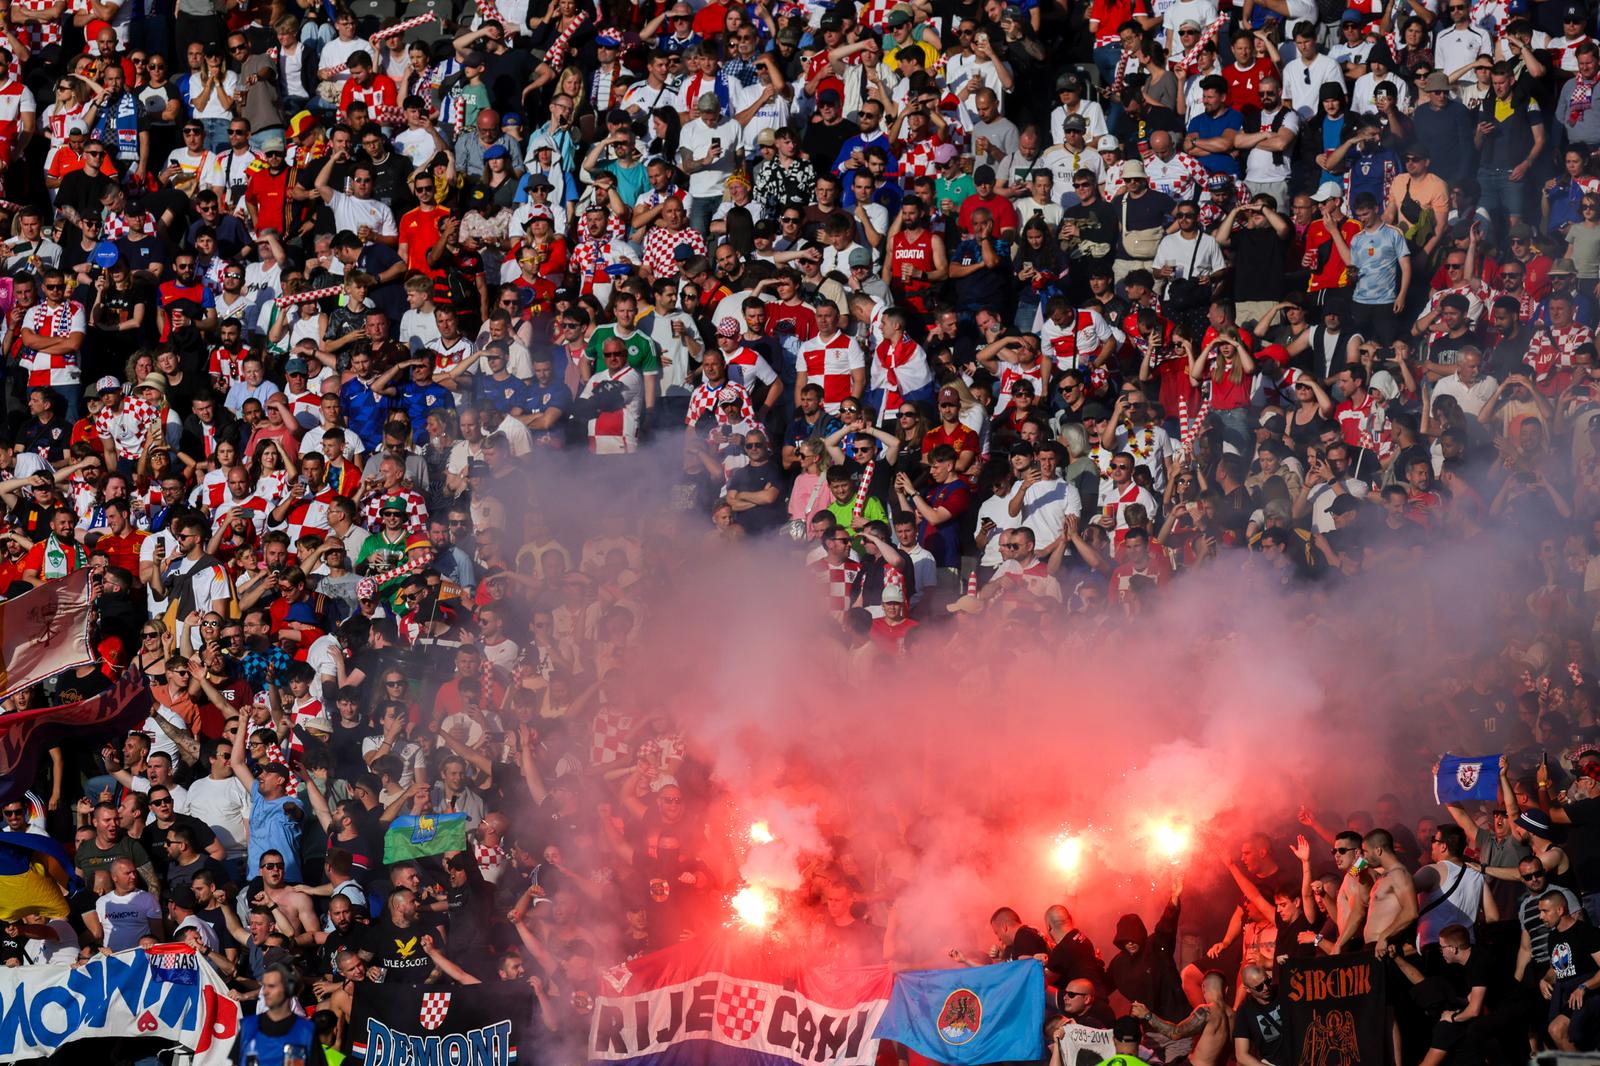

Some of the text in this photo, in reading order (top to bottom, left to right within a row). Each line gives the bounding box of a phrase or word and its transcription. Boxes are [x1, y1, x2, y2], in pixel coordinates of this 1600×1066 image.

[895, 249, 924, 259] CROATIA
[1484, 717, 1496, 732] 10
[365, 1017, 512, 1066] DEMONI
